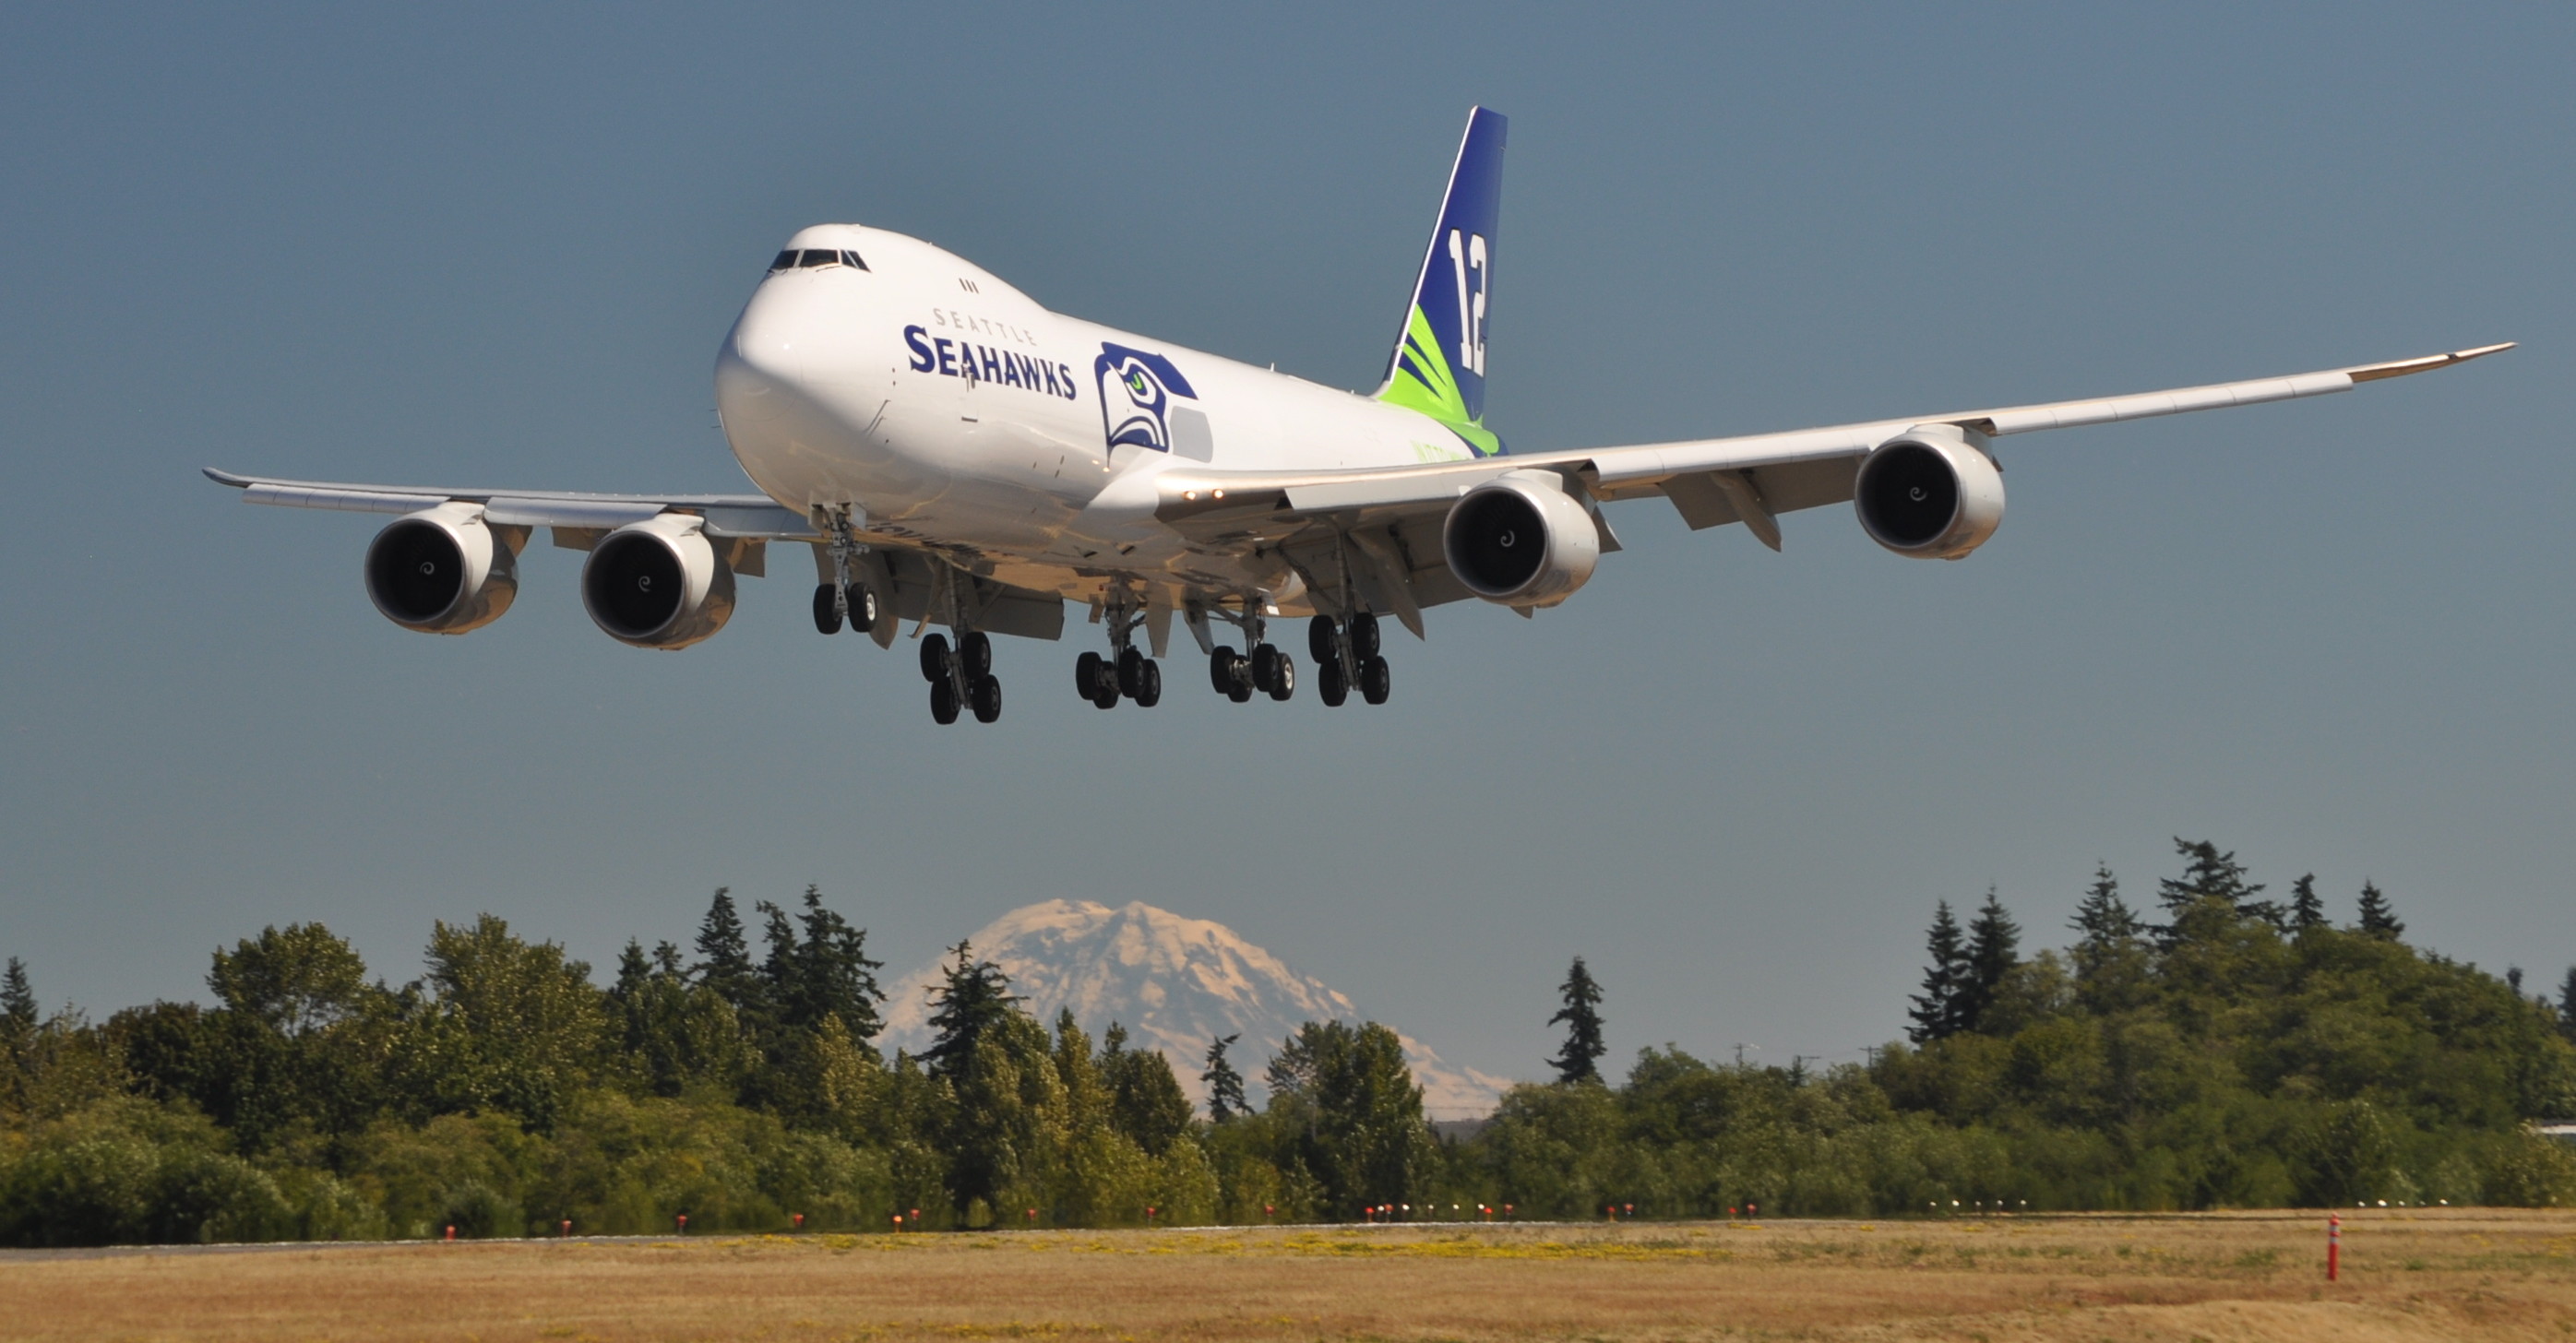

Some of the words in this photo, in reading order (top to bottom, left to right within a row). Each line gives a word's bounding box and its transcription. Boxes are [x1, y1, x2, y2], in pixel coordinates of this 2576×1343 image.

[933, 307, 1038, 347] SEATTLE
[1449, 229, 1486, 377] 12
[903, 325, 1077, 400] SEAHAWKS
